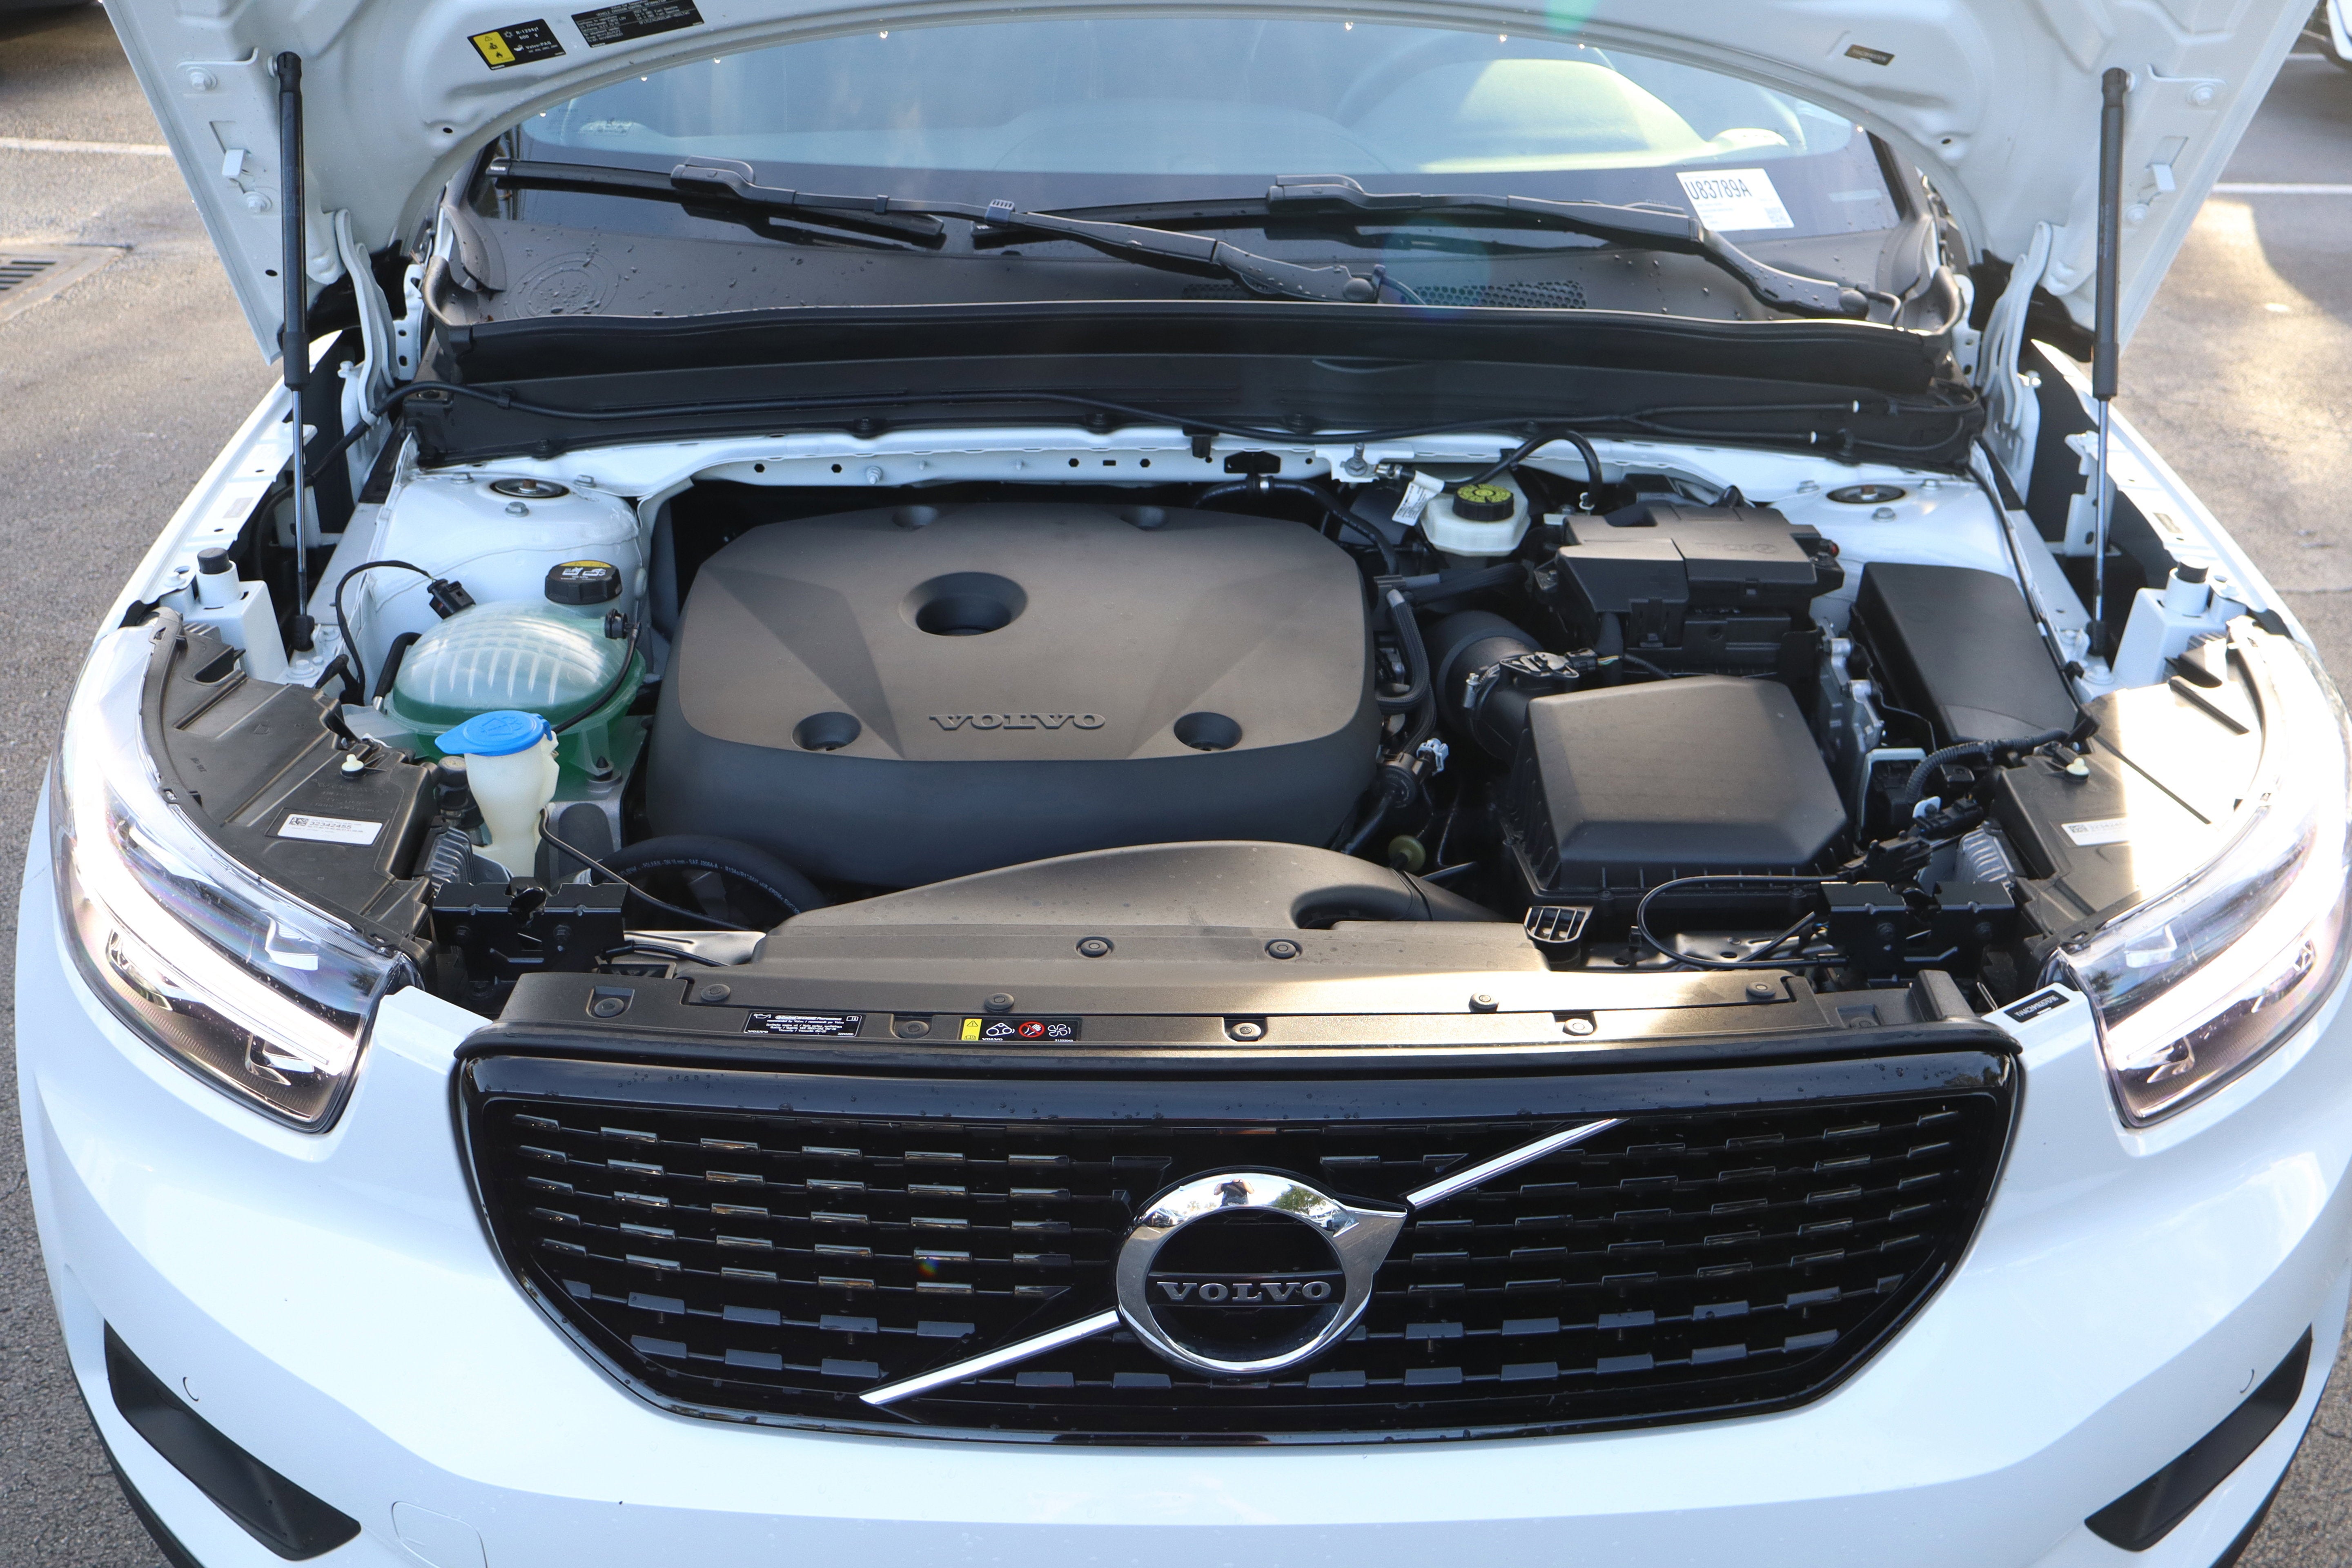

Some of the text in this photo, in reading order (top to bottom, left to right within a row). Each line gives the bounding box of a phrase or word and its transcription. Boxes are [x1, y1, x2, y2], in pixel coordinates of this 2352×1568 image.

[1684, 178, 1753, 200] U83789A
[929, 713, 1106, 731] VOLVO
[1156, 1281, 1332, 1302] VOLVO
